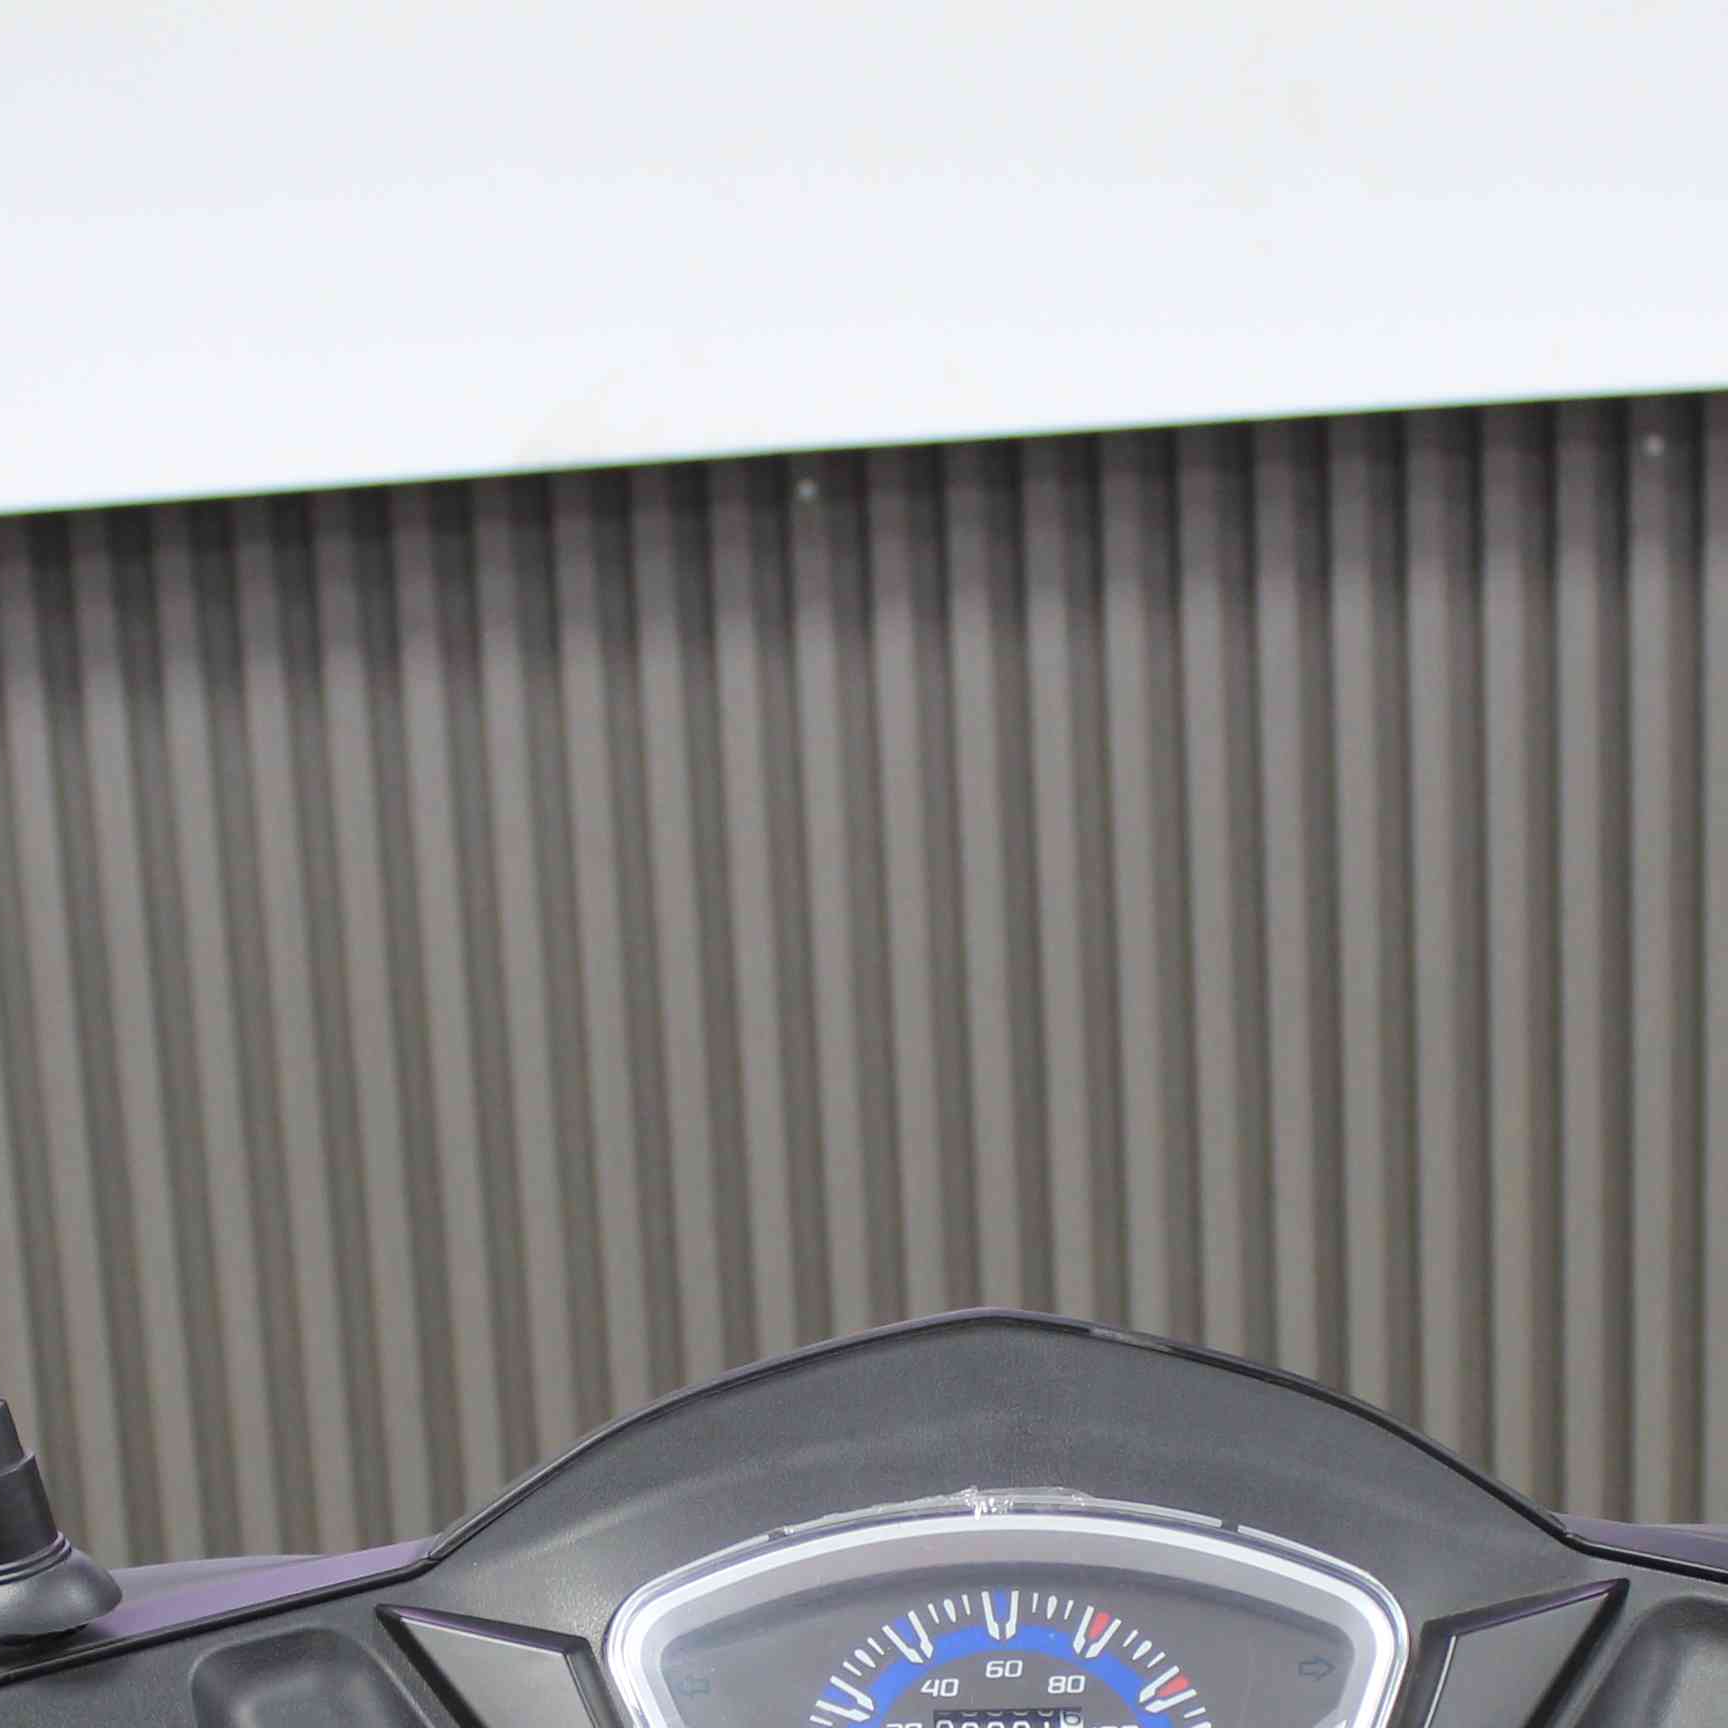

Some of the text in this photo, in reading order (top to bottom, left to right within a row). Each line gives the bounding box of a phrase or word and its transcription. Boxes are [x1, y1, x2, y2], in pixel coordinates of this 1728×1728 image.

[985, 1660, 1023, 1678] 60
[921, 1678, 959, 1697] 40
[1048, 1675, 1085, 1694] 80
